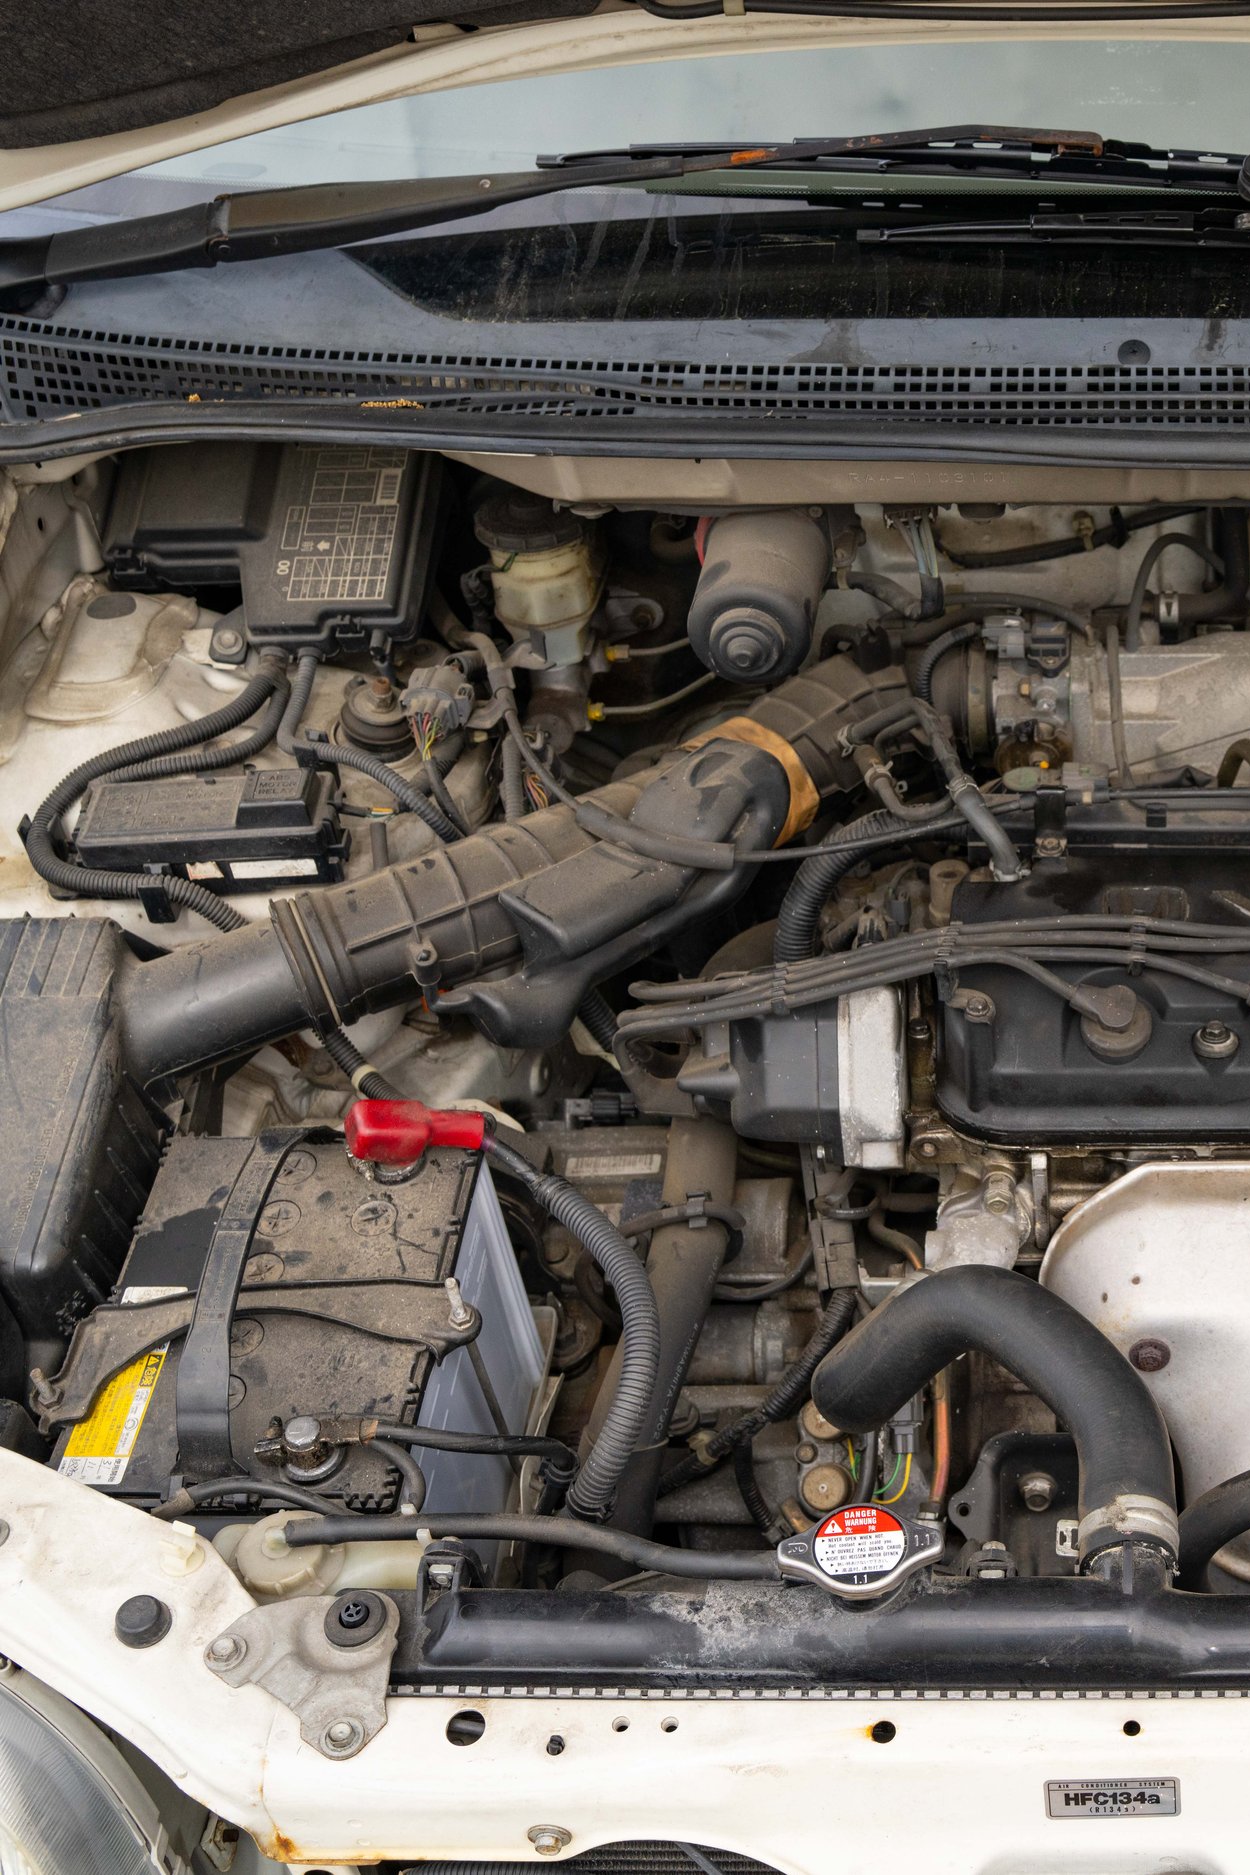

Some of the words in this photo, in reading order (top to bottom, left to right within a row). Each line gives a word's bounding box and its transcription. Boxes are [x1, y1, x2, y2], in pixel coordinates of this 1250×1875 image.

[847, 471, 1010, 485] RA4-1103101
[268, 773, 291, 782] ABS
[258, 781, 298, 789] MOTOR
[257, 787, 296, 796] RELAY
[844, 1509, 877, 1519] DANGER
[844, 1517, 877, 1527] WARNUNG
[914, 1533, 931, 1547] 1.1
[853, 1574, 868, 1584] 1.1
[1063, 1791, 1161, 1807] HFC134a
